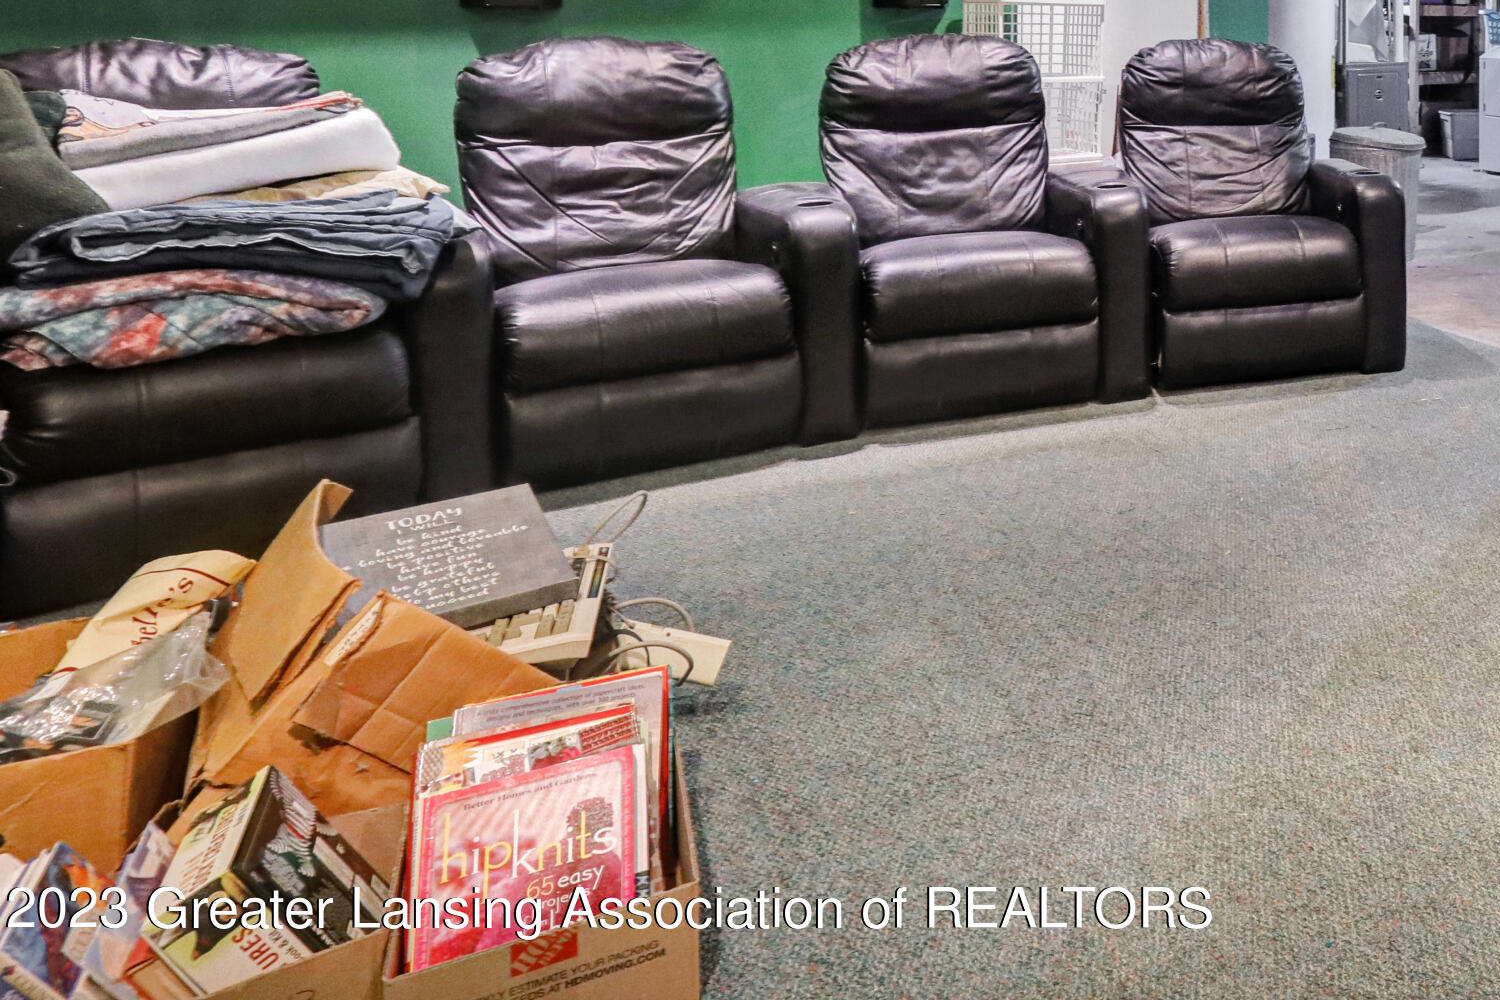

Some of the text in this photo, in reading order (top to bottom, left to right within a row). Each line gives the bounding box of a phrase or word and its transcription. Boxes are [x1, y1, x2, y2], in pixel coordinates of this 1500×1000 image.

[386, 507, 462, 530] TODAY
[410, 520, 457, 532] WILL
[376, 528, 486, 558] have courage
[396, 525, 463, 546] be kind
[358, 551, 416, 568] loving
[421, 542, 454, 554] and
[387, 543, 484, 569] be positive
[401, 552, 477, 574] have fun
[391, 562, 496, 593] be grateful
[397, 558, 484, 582] be happy
[443, 571, 501, 589] others
[460, 577, 498, 593] best
[463, 771, 598, 811] Better Homes and Gardens
[439, 809, 618, 904] hipknits
[526, 864, 605, 899] 65 easy
[508, 971, 568, 998] ESTIMATE
[571, 958, 605, 975] YOUR
[607, 940, 661, 964] PACKING
[549, 983, 563, 993] AT
[563, 949, 667, 988] HDMOVING.COM
